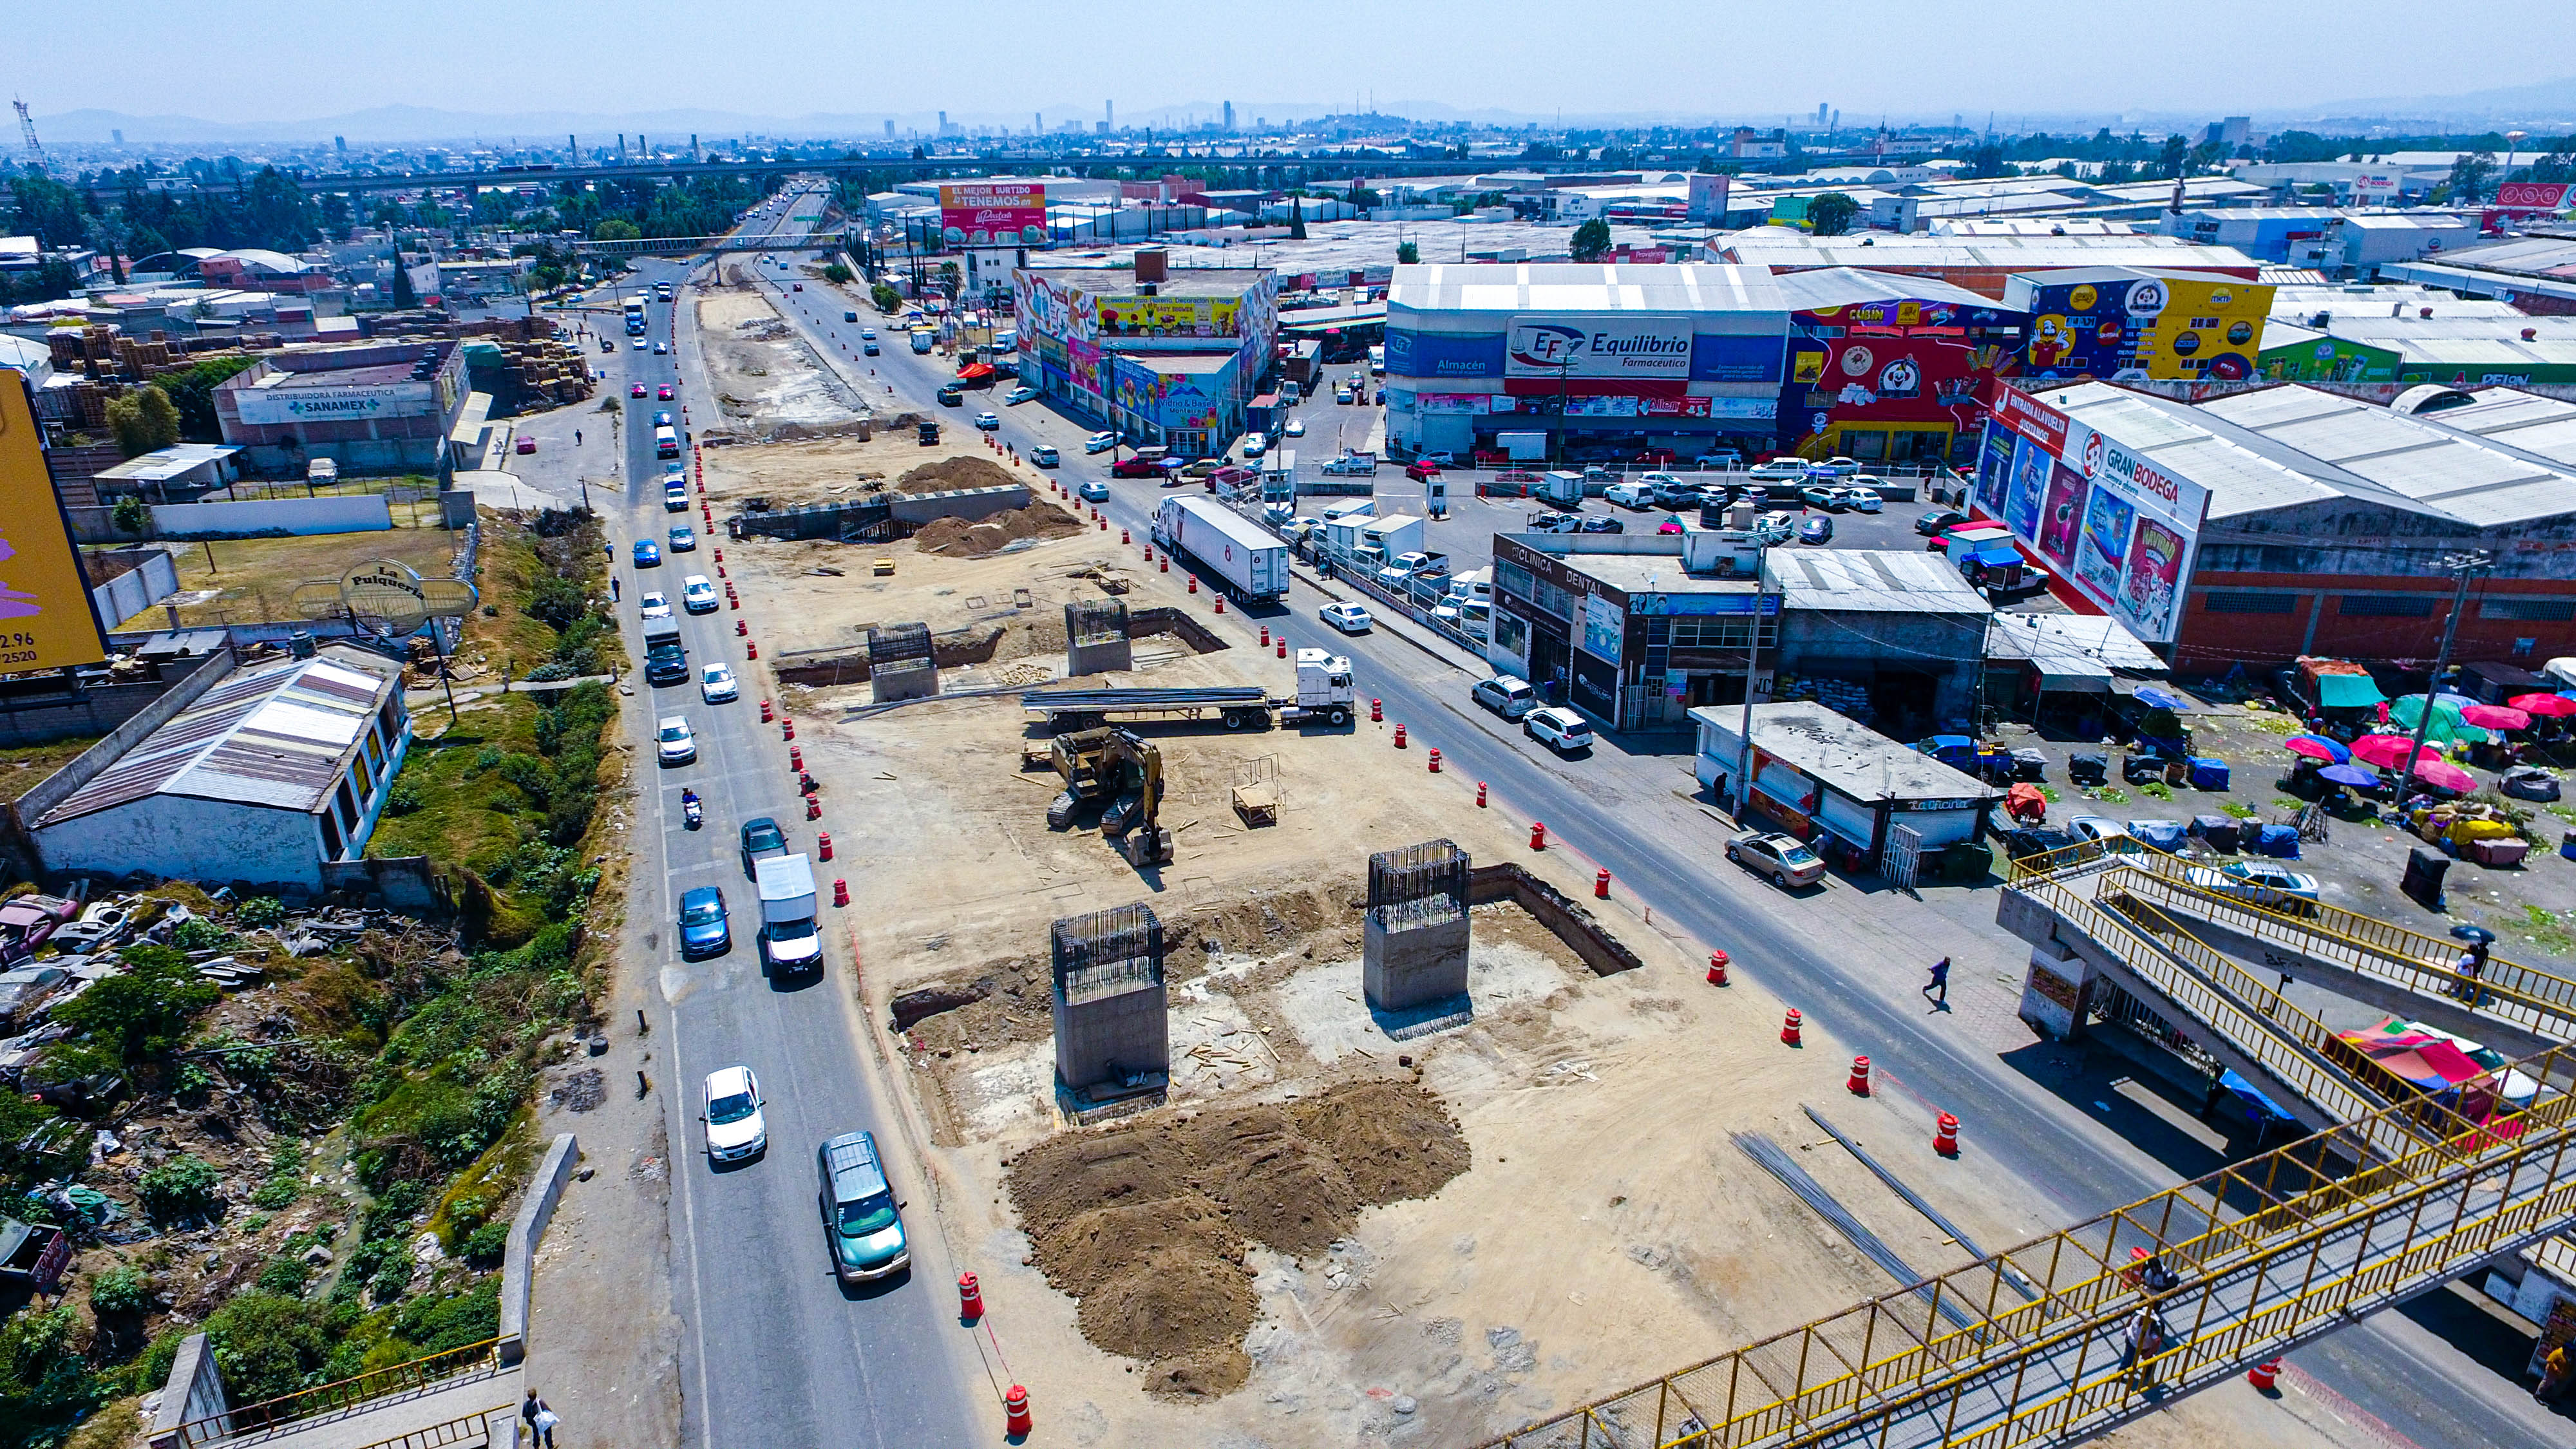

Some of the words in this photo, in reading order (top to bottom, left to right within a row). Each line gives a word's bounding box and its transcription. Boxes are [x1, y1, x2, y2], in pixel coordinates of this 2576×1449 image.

[963, 187, 992, 195] MEJOR
[961, 196, 1019, 206] TENEMOS
[1533, 333, 1562, 359] EF
[1591, 333, 1688, 355] Equilibrio
[1437, 360, 1486, 370] Almacén
[267, 392, 330, 401] DISTRIBUIDORA
[333, 389, 395, 399] FARMACEUTICA
[305, 401, 366, 412] SANAMEX
[1649, 397, 1680, 411] Allen
[2010, 393, 2034, 417] ENTRADA
[2045, 411, 2065, 434] VUELTA
[2107, 449, 2136, 479] GRAN
[2134, 462, 2178, 506] BODEGA
[377, 566, 398, 578] La
[1519, 549, 1552, 574] CLINICA
[1566, 570, 1603, 597] DENTAL
[352, 576, 425, 600] Pulqueria
[1426, 614, 1476, 651] ESTACIONAMIENTO
[0, 650, 37, 663] 2520
[1908, 800, 1926, 810] La
